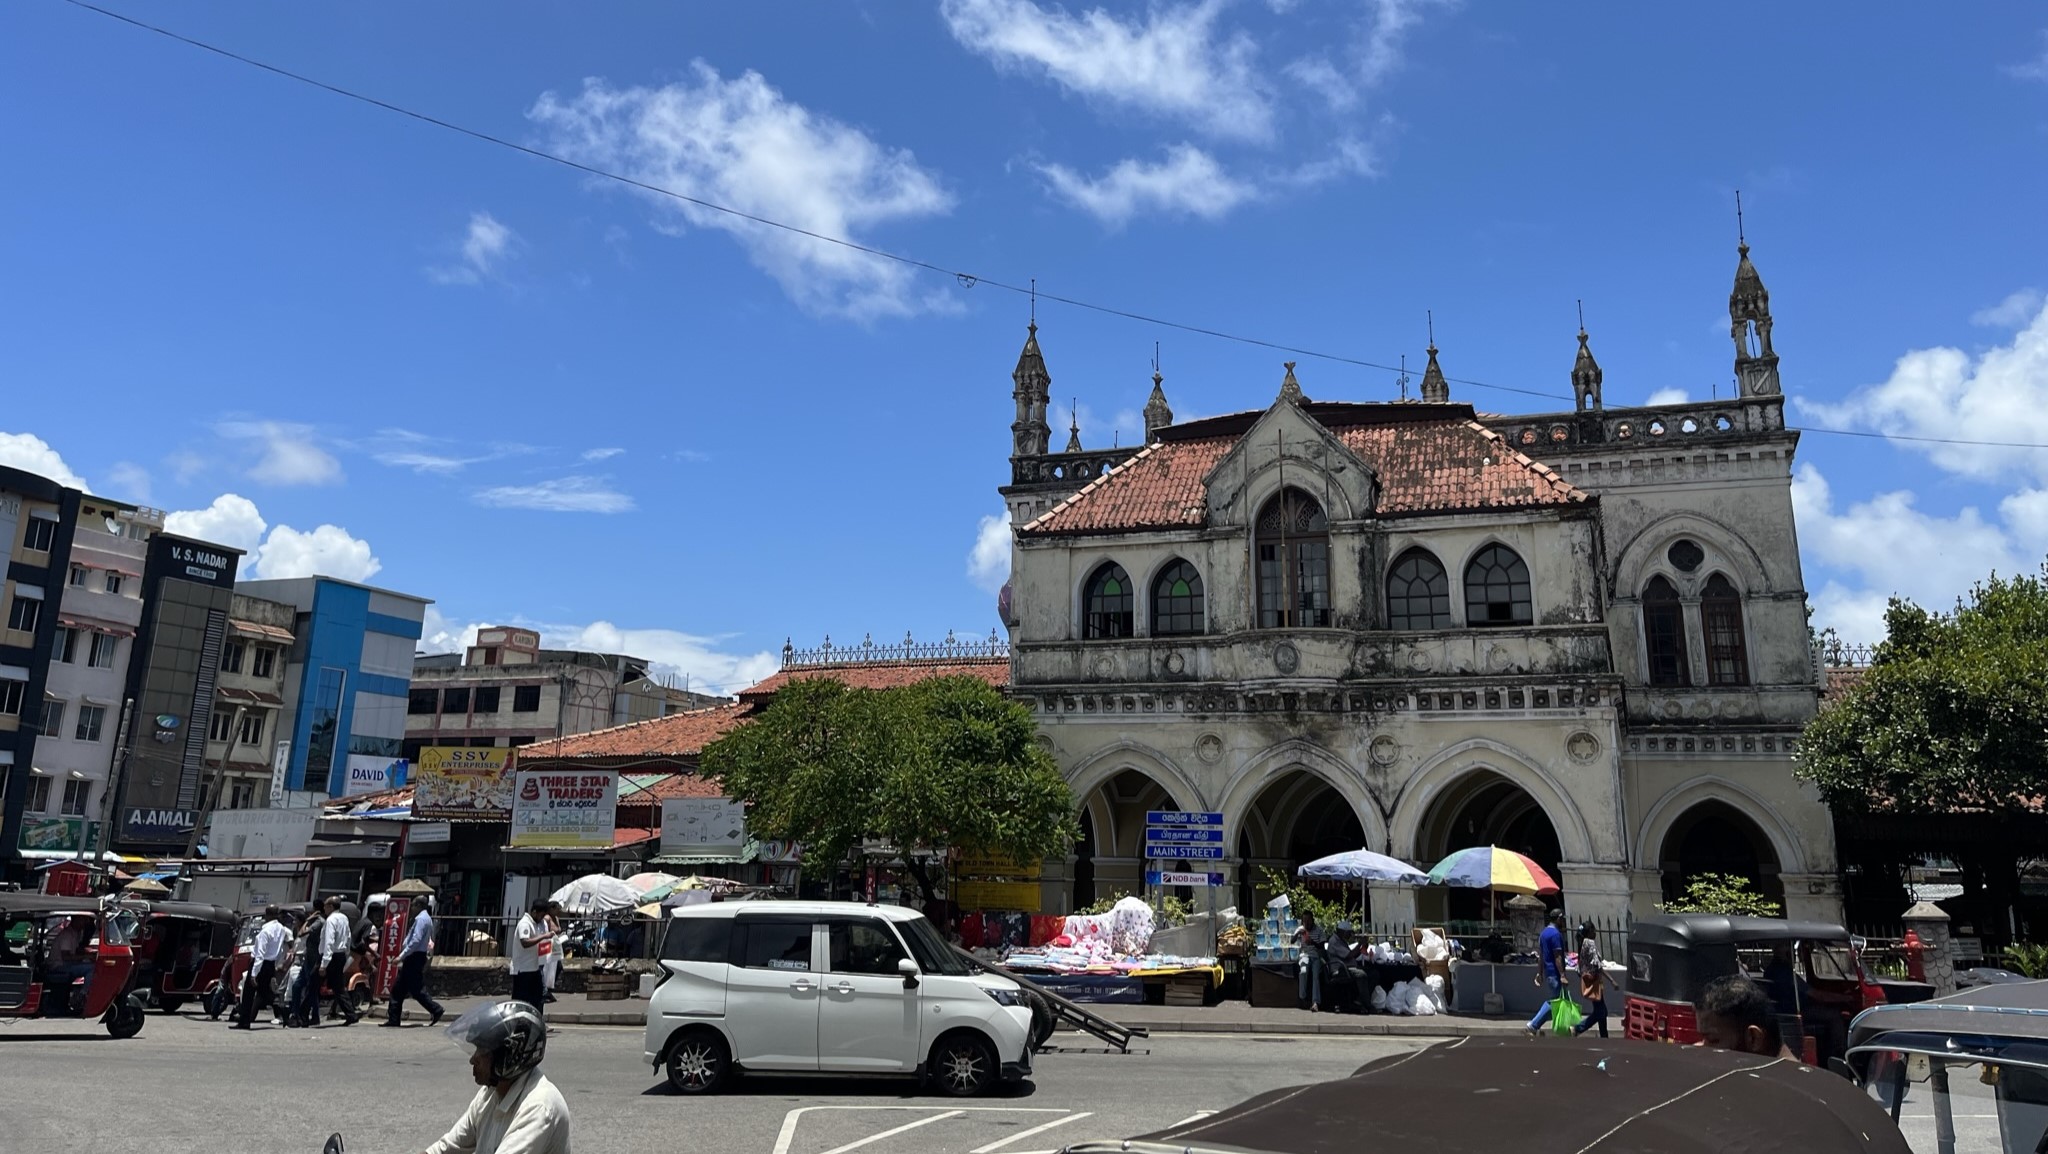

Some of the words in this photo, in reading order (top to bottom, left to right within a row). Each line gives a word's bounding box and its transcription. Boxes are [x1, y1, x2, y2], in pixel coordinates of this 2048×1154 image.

[172, 546, 181, 560] V.
[183, 548, 194, 562] S.
[196, 551, 228, 570] NADAR
[441, 761, 500, 769] ENTERPRISES
[352, 768, 384, 781] DAVID
[539, 776, 578, 787] THREE
[580, 776, 611, 787] STAR
[547, 788, 604, 799] TRADERS
[1153, 847, 1177, 856] MAIN
[1180, 847, 1216, 857] STREET
[387, 913, 401, 952] PARTY
[381, 955, 396, 994] VILLA
